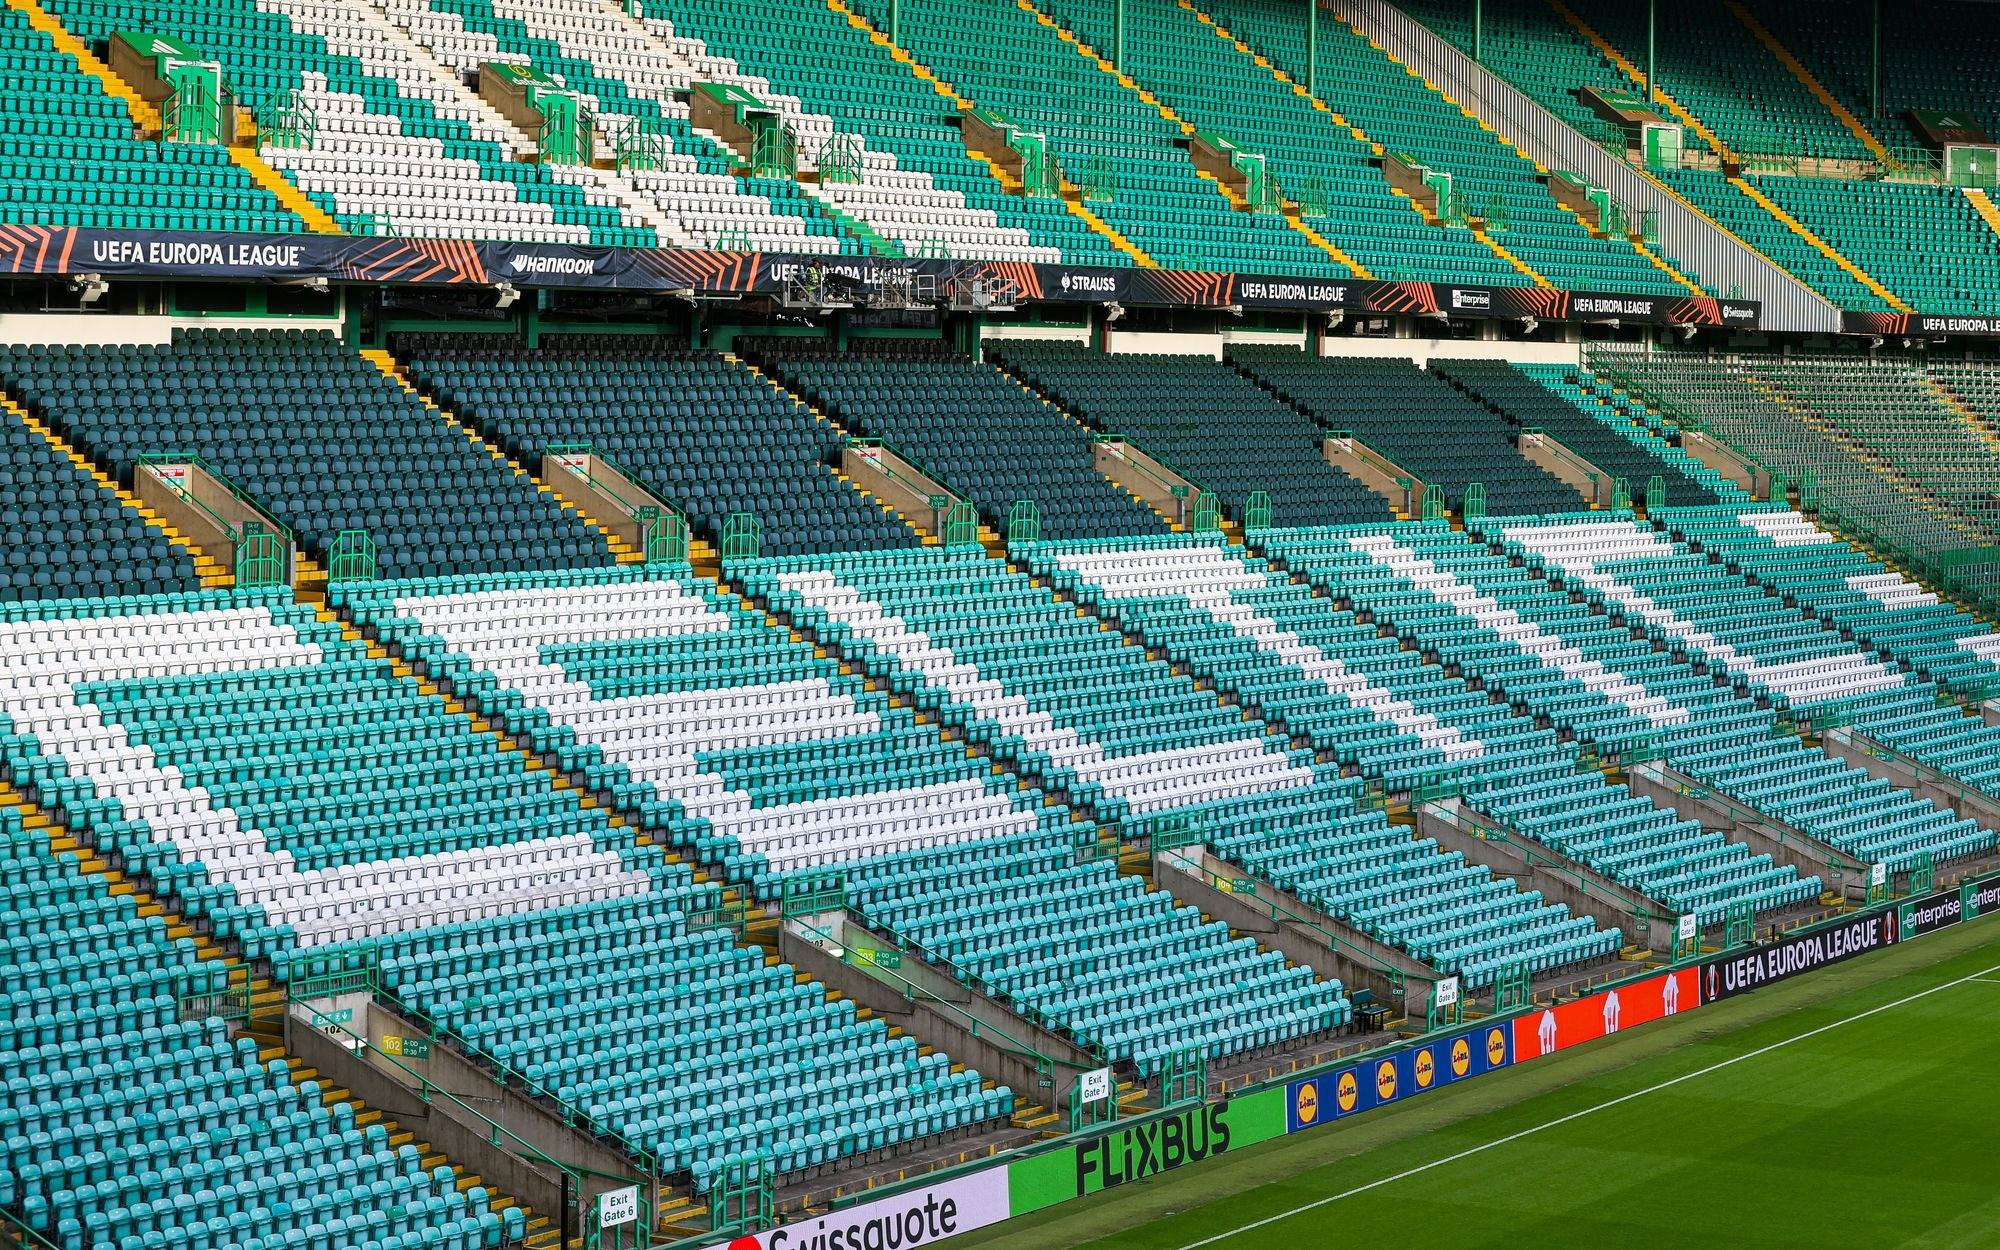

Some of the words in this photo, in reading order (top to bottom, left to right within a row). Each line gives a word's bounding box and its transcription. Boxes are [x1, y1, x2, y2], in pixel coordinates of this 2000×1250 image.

[93, 240, 144, 263] UEFA
[149, 243, 224, 265] EUROPA
[229, 244, 300, 267] LEAGUE
[1072, 276, 1116, 292] STRAUSS
[1241, 282, 1267, 298] UEFA
[1269, 284, 1306, 300] EUROPA
[1308, 286, 1344, 302] LEAGUE
[1454, 294, 1489, 306] enterprise
[1574, 298, 1594, 312] UEFA
[1595, 299, 1623, 313] EUROPA
[1624, 301, 1651, 315] LEAGUE
[1922, 318, 1947, 331] UEFA
[1948, 318, 1988, 332] EUROPA
[1903, 898, 1960, 929] enterprise
[1684, 919, 1692, 927] Exit
[1725, 954, 1766, 991] UEFA
[1768, 935, 1825, 978] EUROPA
[1826, 917, 1878, 960] LEAGUE
[1442, 983, 1453, 992] Exit
[1438, 994, 1450, 1003] Gate
[386, 1039, 400, 1051] 102
[1088, 1075, 1102, 1085] Exit
[1084, 1087, 1100, 1098] Gate
[1101, 1084, 1106, 1094] 7
[610, 1194, 628, 1207] Exit
[604, 1208, 626, 1222] Gate
[628, 1205, 634, 1216] 6
